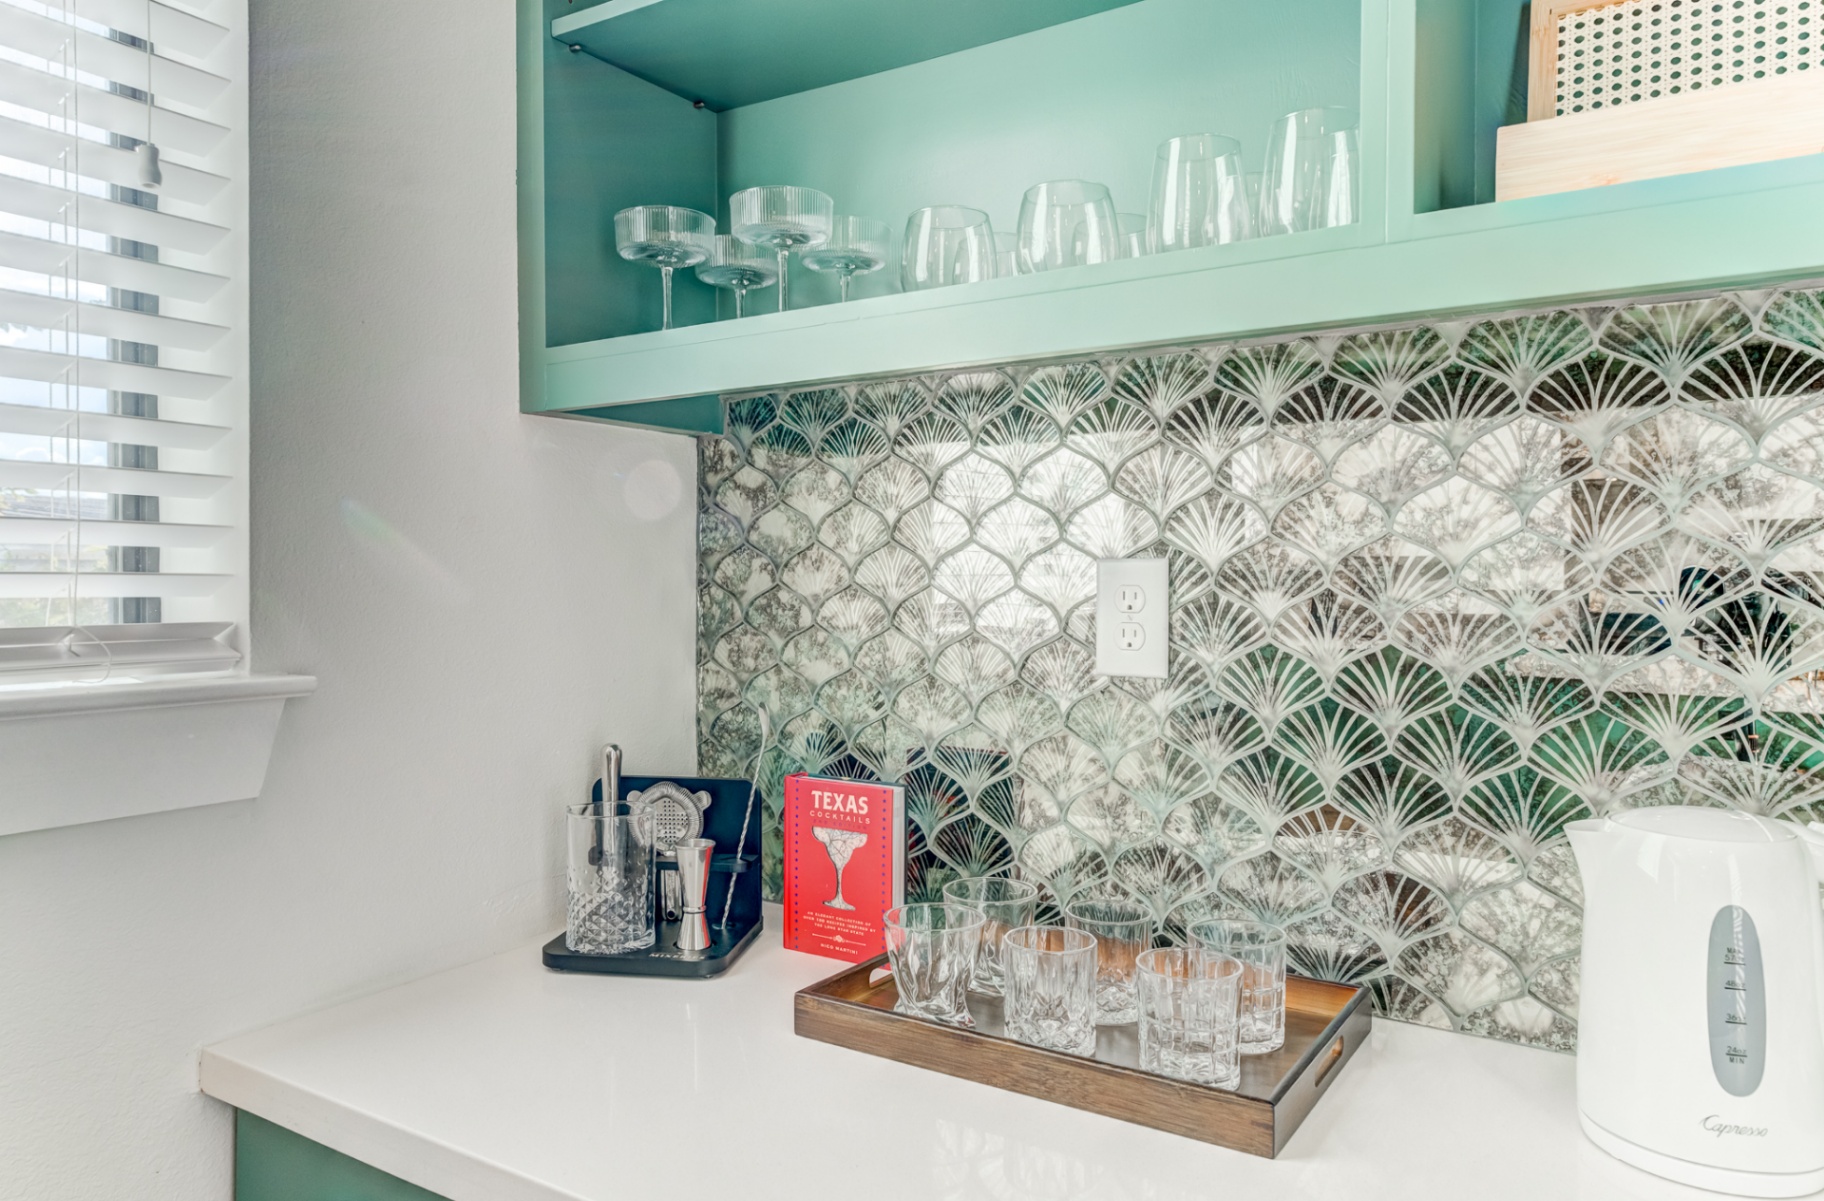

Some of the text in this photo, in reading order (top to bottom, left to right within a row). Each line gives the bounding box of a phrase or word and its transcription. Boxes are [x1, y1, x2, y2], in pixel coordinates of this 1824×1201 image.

[811, 790, 868, 815] TEXAS
[809, 810, 871, 825] COCKTAILS
[835, 946, 858, 955] MARTINI
[1729, 1056, 1745, 1064] MIN
[1699, 1114, 1768, 1138] Capresso
